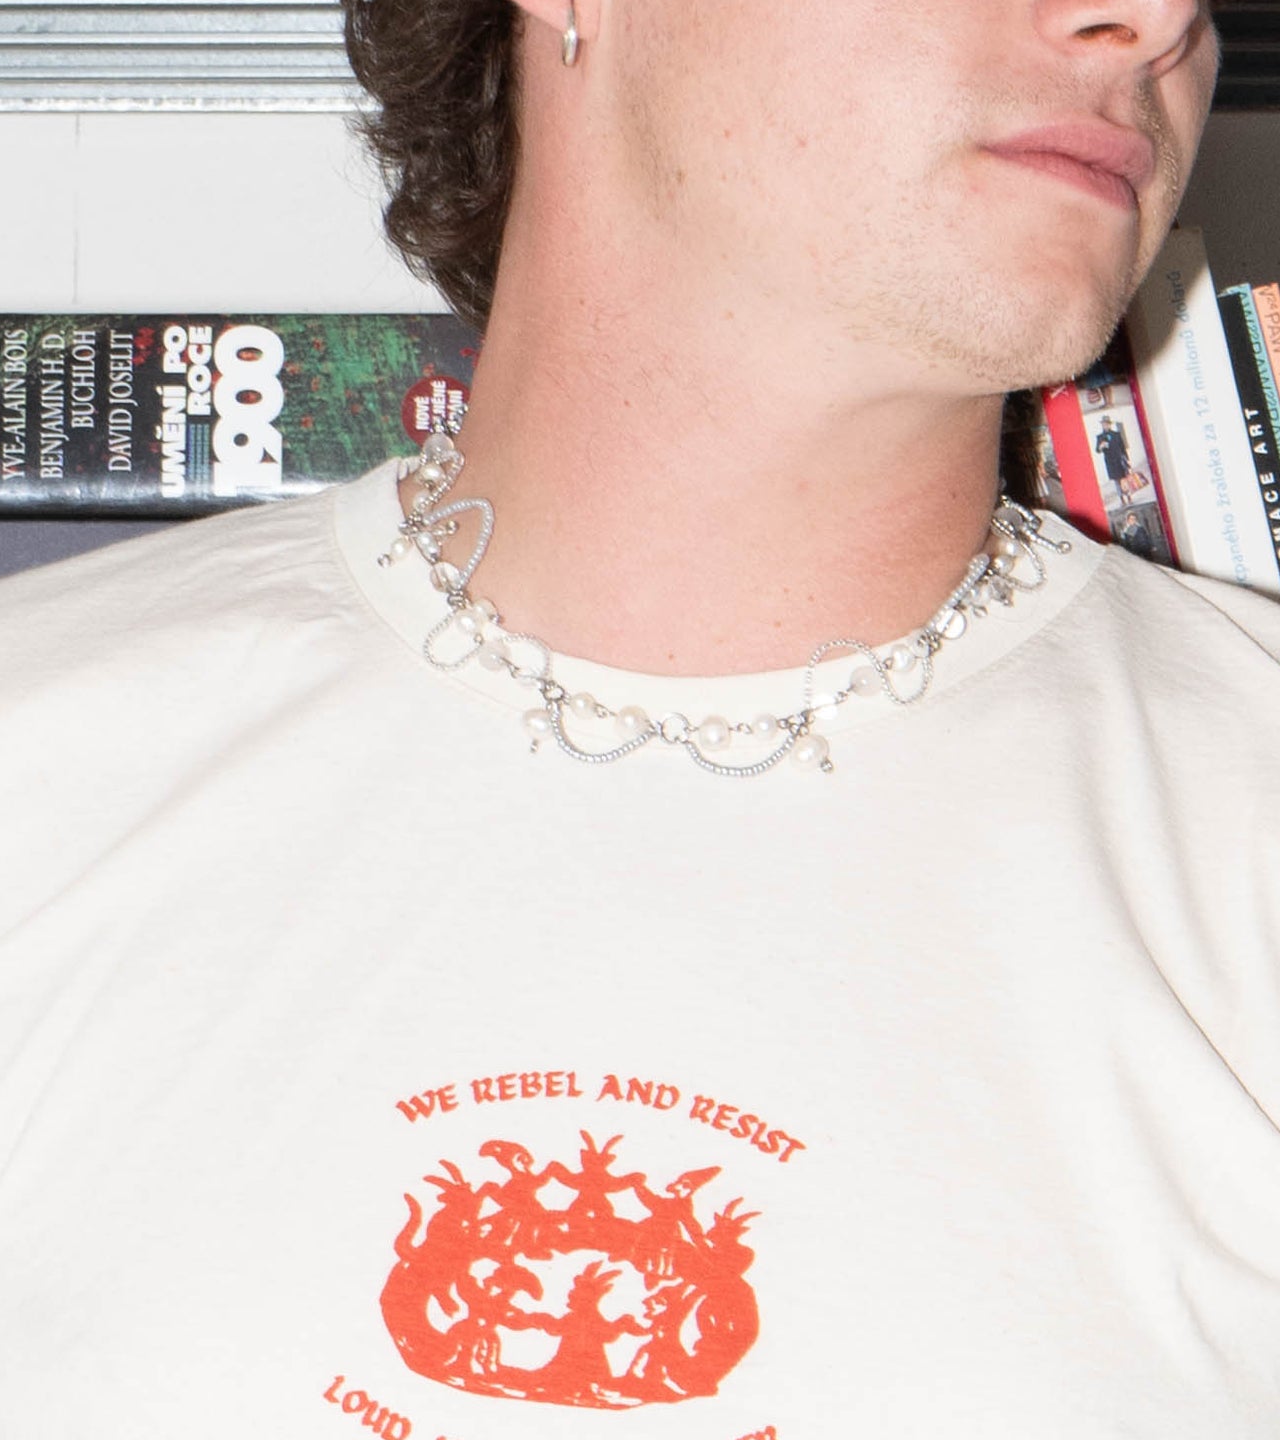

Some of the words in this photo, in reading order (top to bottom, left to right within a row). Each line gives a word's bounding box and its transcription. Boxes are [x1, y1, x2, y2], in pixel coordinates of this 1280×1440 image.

[1, 328, 29, 375] BOIS
[38, 355, 65, 375] H.
[40, 329, 66, 350] D.
[69, 327, 97, 429] BUCHLOH
[107, 328, 140, 409] JOSELIT
[162, 324, 189, 374] PO
[186, 325, 213, 416] ROCE
[0, 377, 31, 484] YVE-ALAIN
[38, 379, 68, 482] BENJAMIN
[107, 408, 134, 475] DAVID
[158, 385, 189, 501] UMĚNÍ
[211, 324, 288, 501] 1900
[1244, 408, 1270, 457] ART
[395, 1084, 459, 1123] WE
[469, 1070, 583, 1105] REBEL
[596, 1074, 681, 1111] AND
[688, 1094, 807, 1163] RESIST
